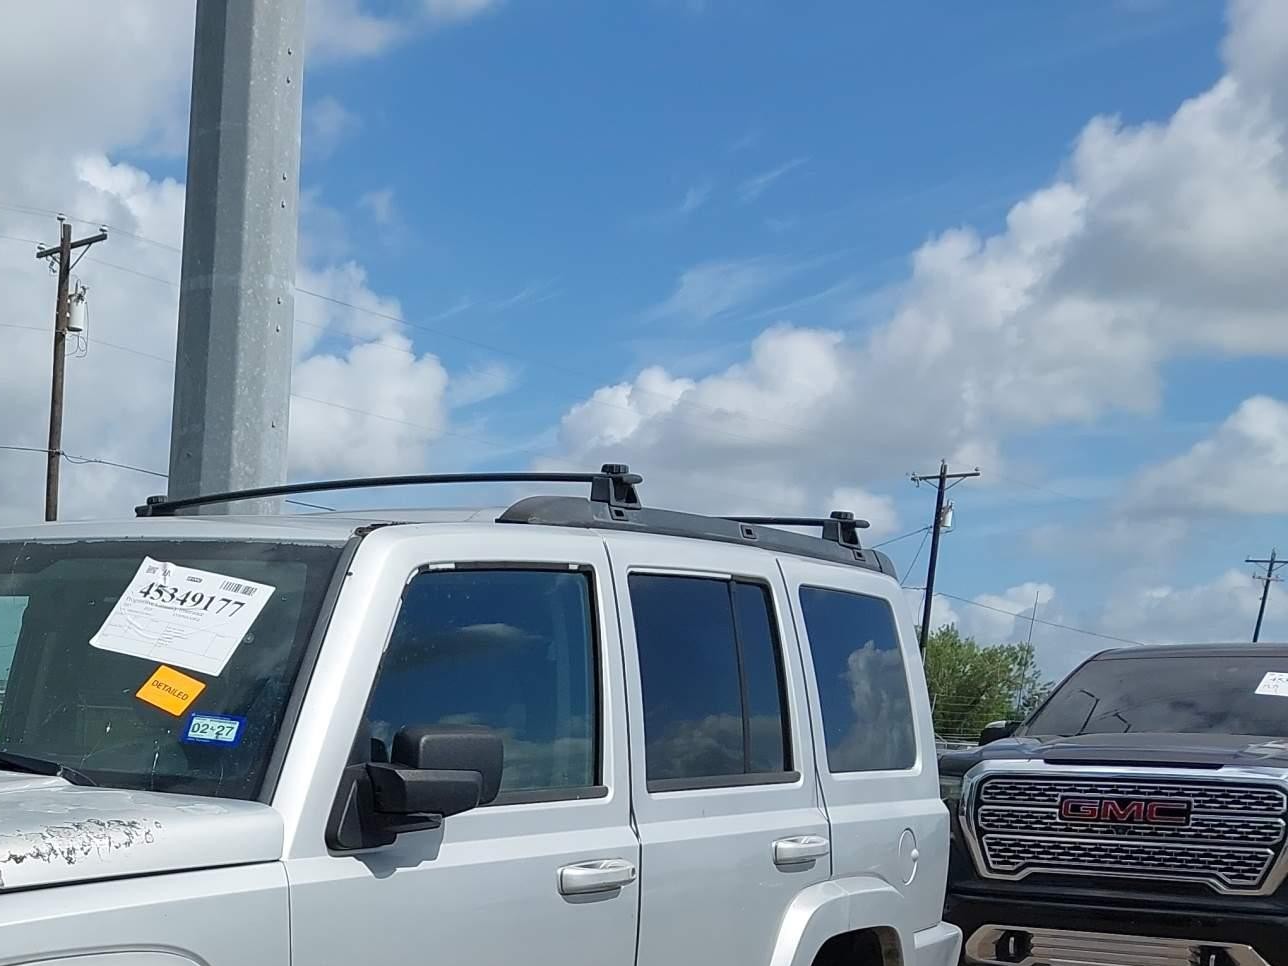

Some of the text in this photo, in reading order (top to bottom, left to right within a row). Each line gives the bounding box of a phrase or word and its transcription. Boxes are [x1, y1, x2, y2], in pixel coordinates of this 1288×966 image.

[139, 582, 246, 617] 45349177
[152, 679, 189, 701] DETAILED
[191, 722, 235, 737] 02 27
[1062, 799, 1186, 822] GMC
